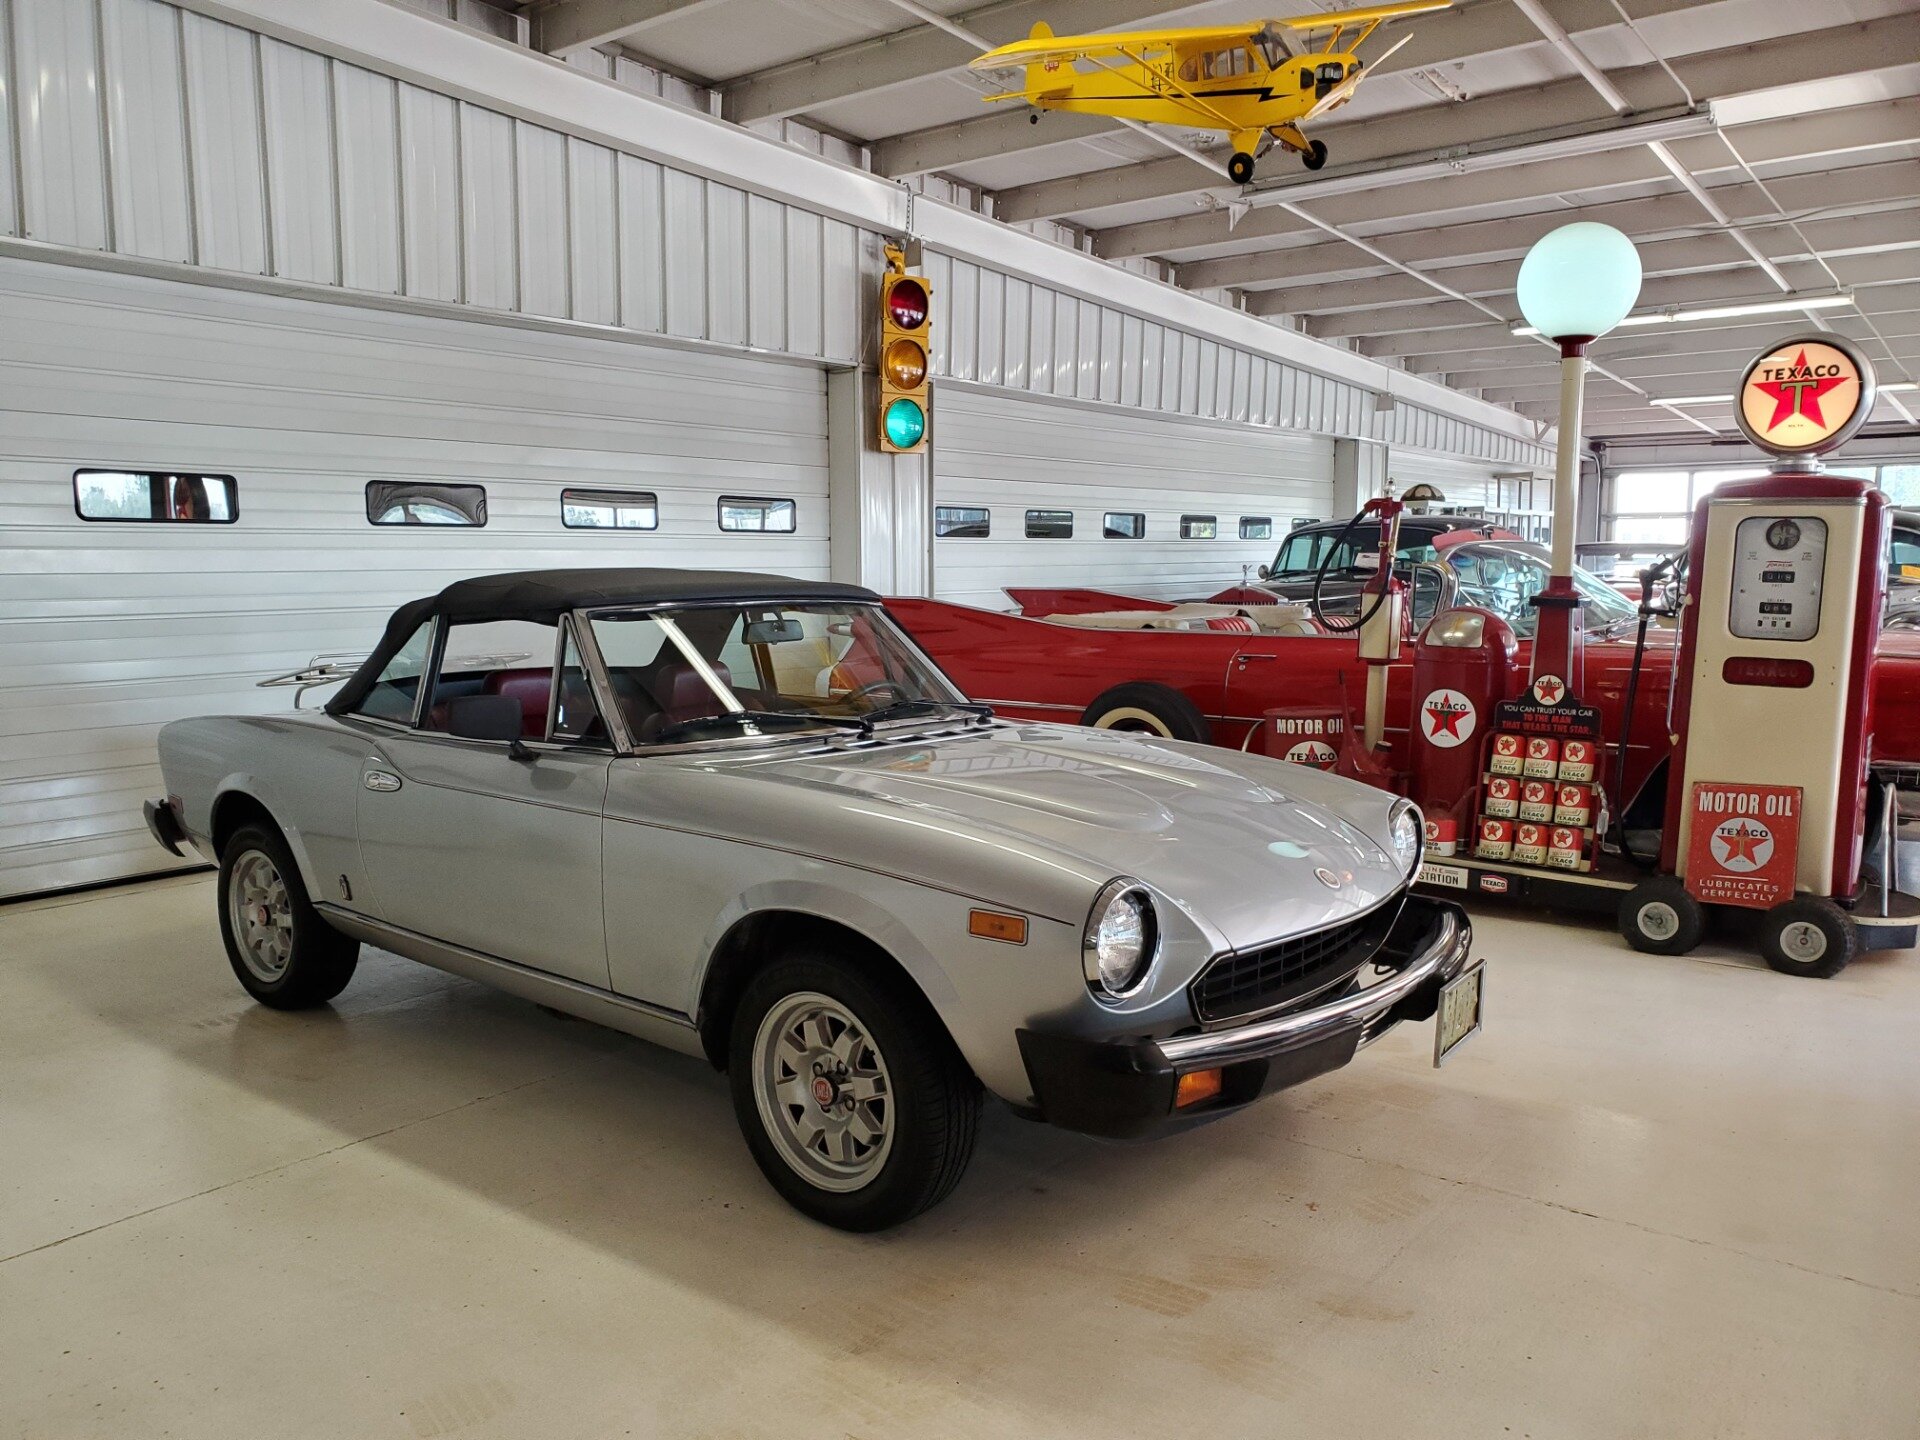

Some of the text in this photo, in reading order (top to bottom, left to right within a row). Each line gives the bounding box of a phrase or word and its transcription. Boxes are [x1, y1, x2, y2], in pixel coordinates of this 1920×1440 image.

[1763, 364, 1840, 381] TEXACO
[1429, 701, 1467, 711] TEXACO
[1504, 704, 1518, 712] YOU
[1558, 708, 1576, 716] YOUR
[1578, 709, 1593, 717] CAR
[1524, 713, 1572, 724] TO THE MAN
[1277, 719, 1323, 734] MOTOR
[1522, 722, 1551, 731] WEARS
[1290, 752, 1335, 761] TEXACO
[1699, 791, 1792, 817] MOTOR OIL
[1719, 827, 1769, 838] TEXACO
[1419, 871, 1459, 885] STATION
[1482, 879, 1505, 888] TEXACO
[1699, 879, 1779, 893] LUBRICATES
[1702, 889, 1775, 902] PERFECTLY
